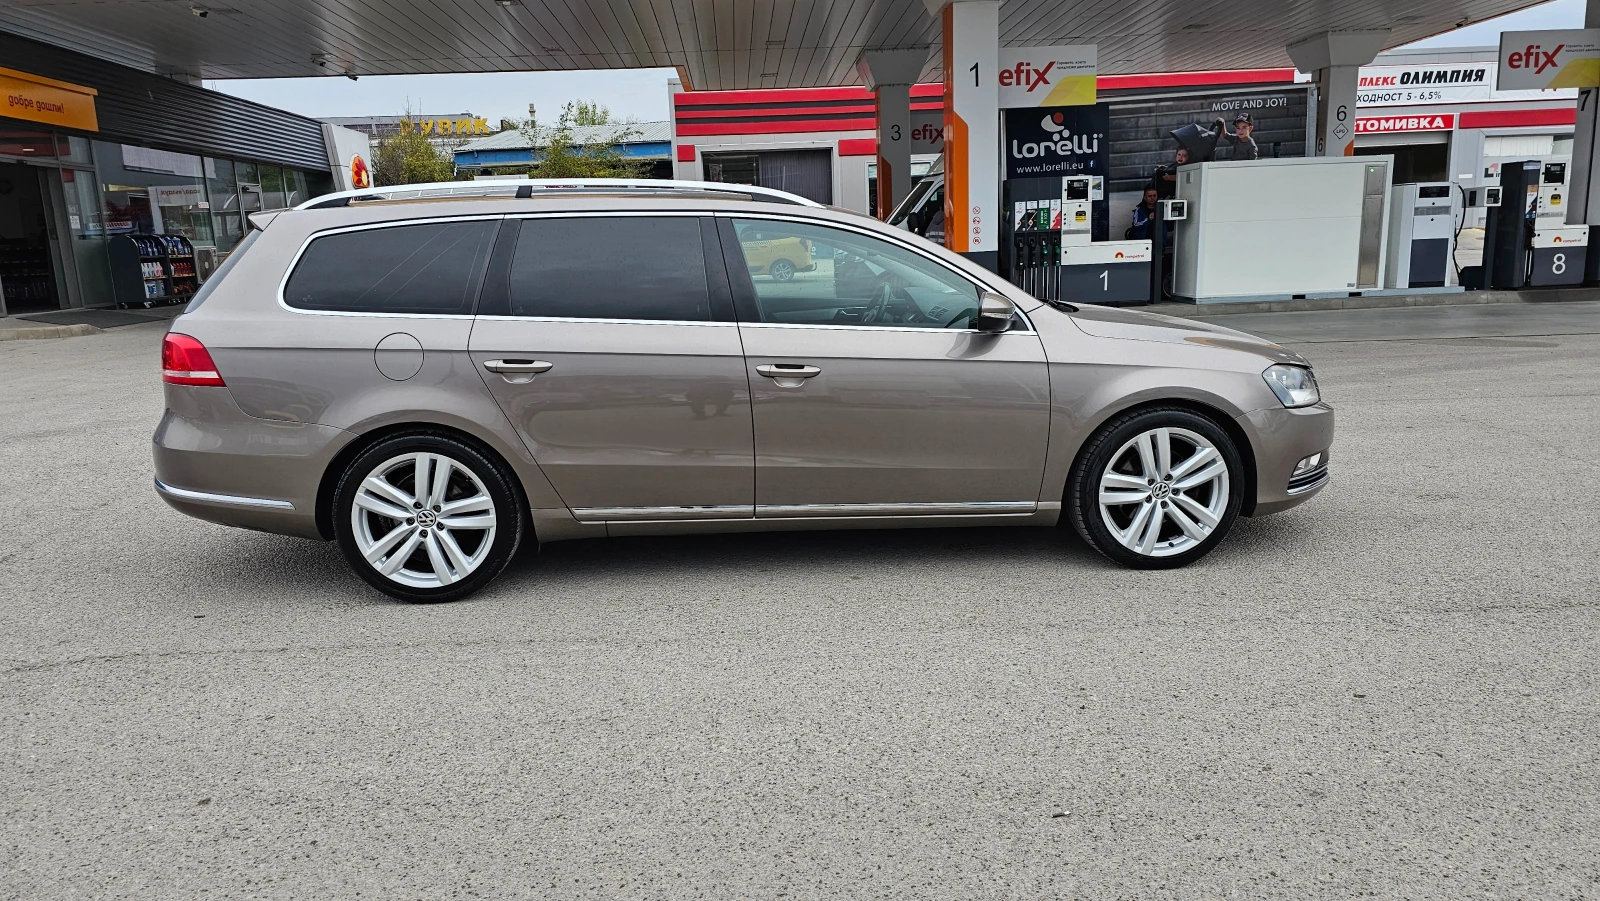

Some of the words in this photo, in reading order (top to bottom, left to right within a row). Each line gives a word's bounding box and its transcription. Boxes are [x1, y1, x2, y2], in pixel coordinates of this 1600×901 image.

[1507, 44, 1565, 74] efix
[969, 62, 979, 87] 1
[998, 61, 1056, 92] efix
[1400, 69, 1486, 85] ОЛИМПИЯ
[8, 95, 34, 109] добре
[36, 101, 65, 114] дошли!
[1212, 101, 1240, 111] MOVE
[1242, 99, 1263, 109] AND
[1265, 98, 1287, 107] JOY!
[1419, 91, 1441, 101] 6,5%
[1580, 90, 1591, 111] 7
[1336, 105, 1347, 121] 6
[890, 124, 901, 140] 3
[1317, 138, 1323, 152] 6
[1016, 162, 1084, 173] www.lorelli.eu
[1552, 253, 1566, 274] 8
[1099, 270, 1108, 291] 1
